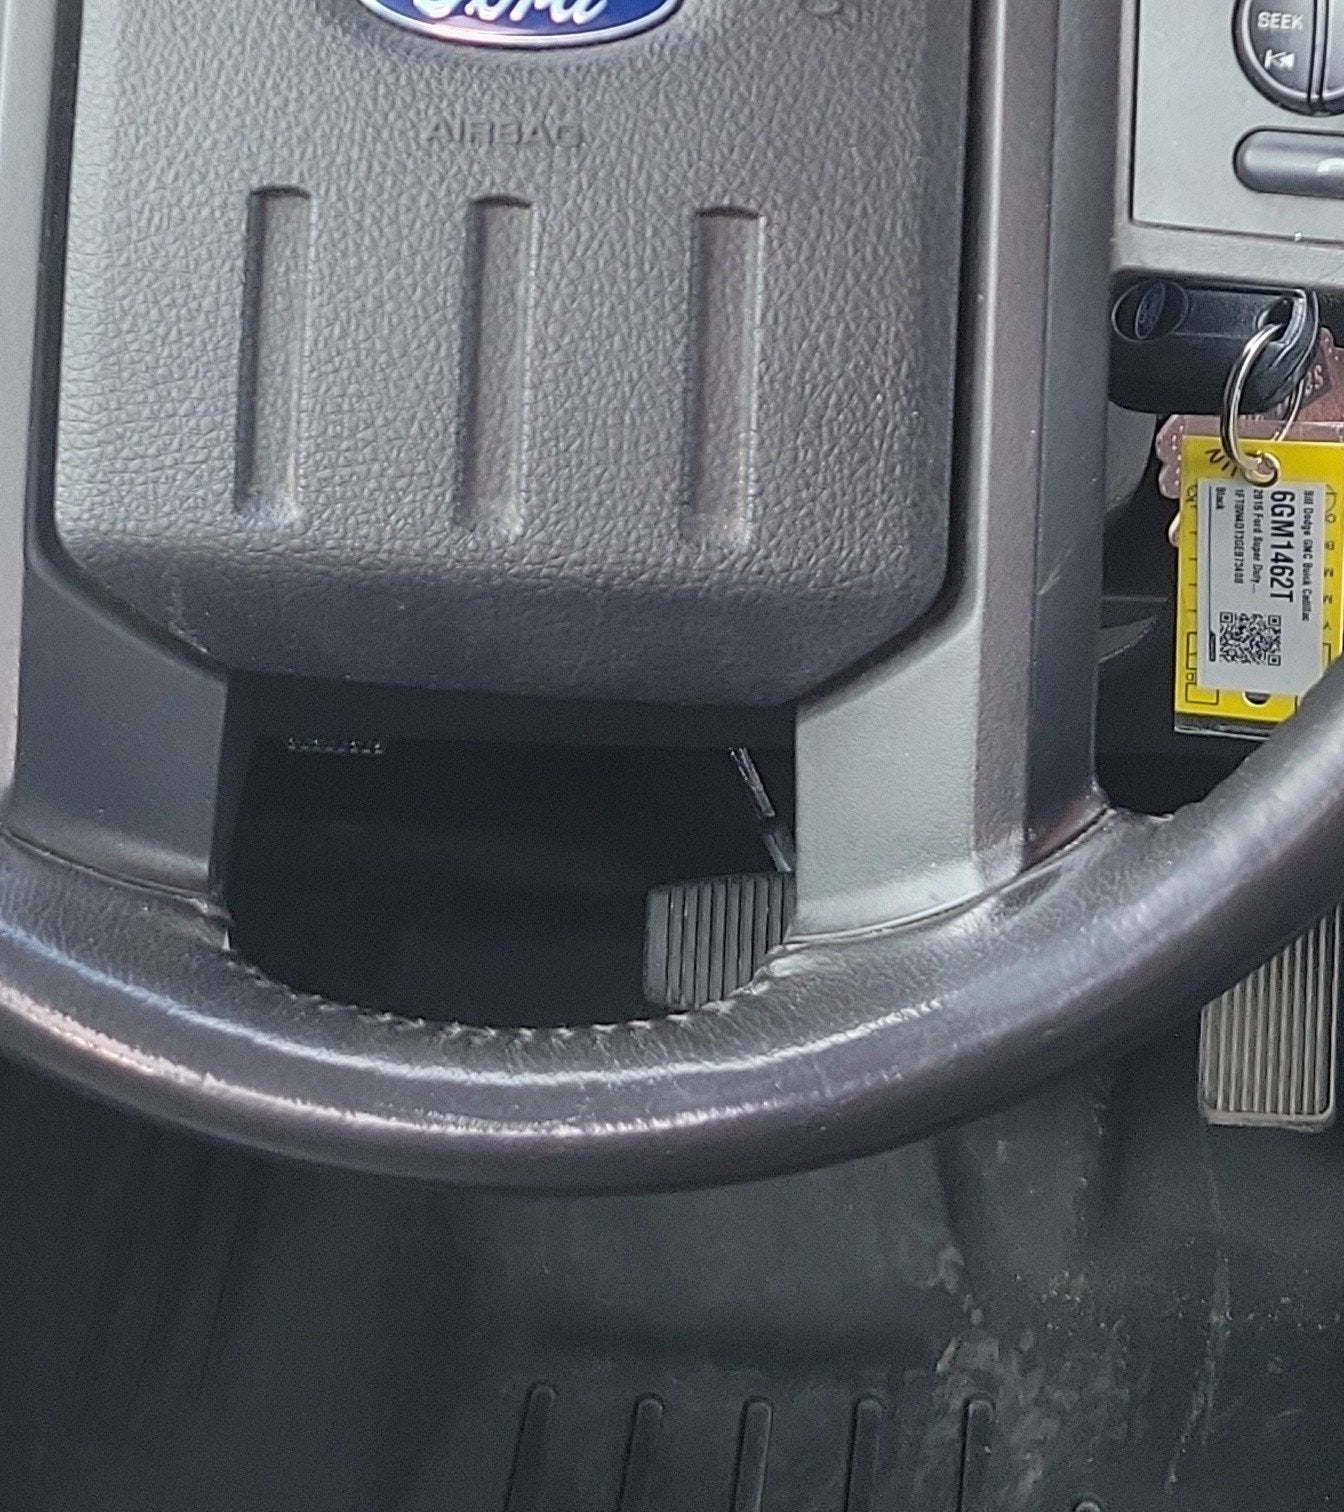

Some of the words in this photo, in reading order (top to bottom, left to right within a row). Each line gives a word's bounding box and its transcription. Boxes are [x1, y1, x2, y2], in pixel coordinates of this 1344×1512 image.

[1257, 10, 1304, 30] SEEK
[1215, 487, 1227, 510] Black
[1253, 513, 1264, 533] Ford
[1301, 508, 1314, 536] Dodge
[1252, 536, 1263, 562] Super
[1269, 490, 1296, 603] 6GM1462T
[1303, 539, 1313, 560] GMC
[1301, 588, 1312, 621] Cadillac
